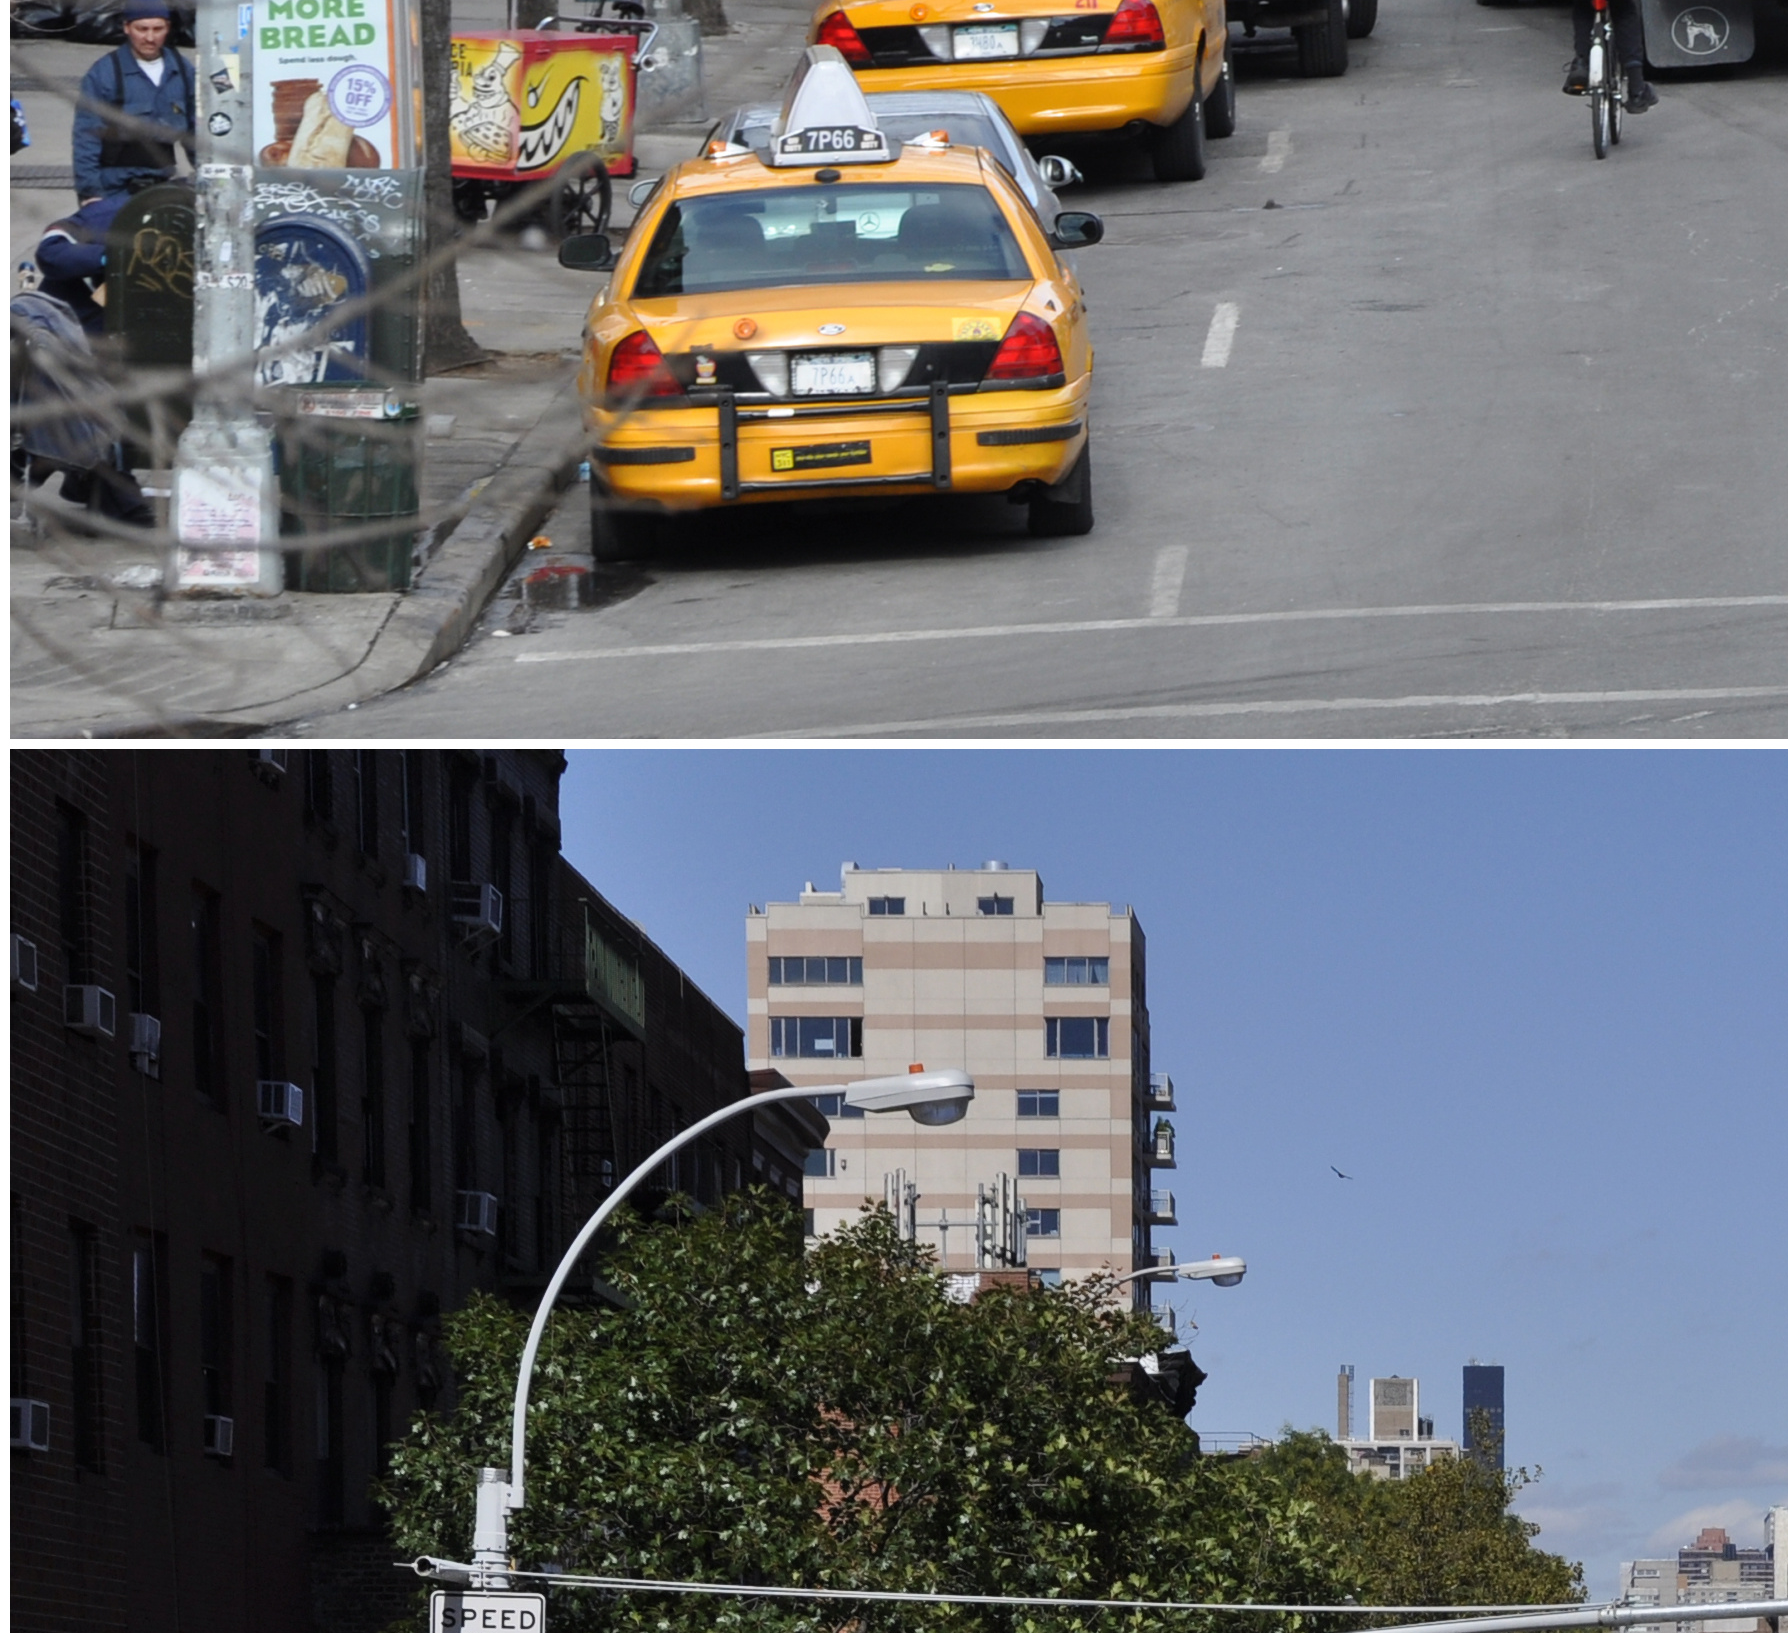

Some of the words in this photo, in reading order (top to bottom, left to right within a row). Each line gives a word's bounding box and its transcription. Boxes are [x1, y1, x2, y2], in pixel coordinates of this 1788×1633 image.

[259, 23, 376, 50] BREAD
[347, 77, 376, 95] 15%
[345, 92, 372, 107] OFF
[806, 130, 855, 150] 7P66
[442, 1608, 536, 1630] SPEED
